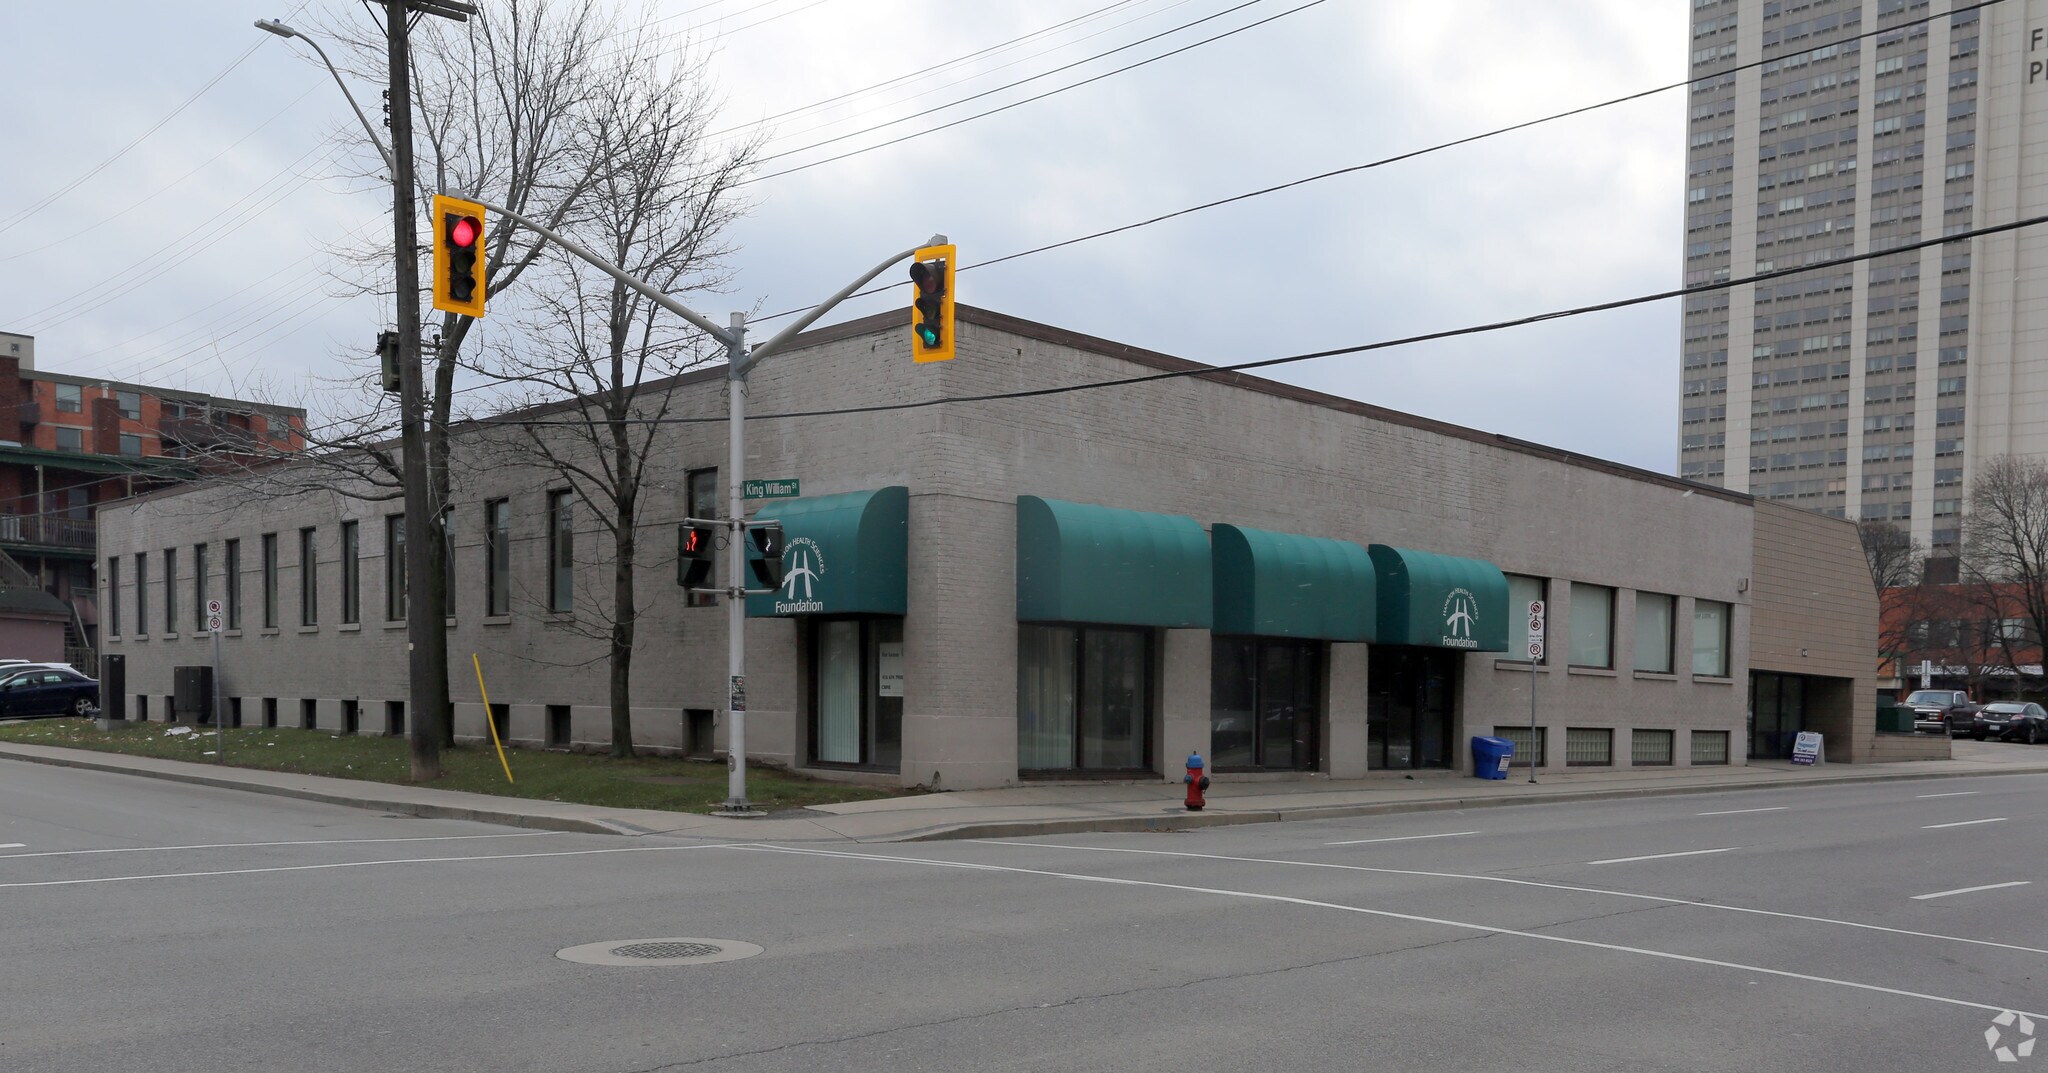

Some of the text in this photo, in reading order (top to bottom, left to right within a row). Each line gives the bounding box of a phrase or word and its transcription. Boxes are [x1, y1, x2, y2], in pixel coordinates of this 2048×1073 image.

[2031, 27, 2048, 52] F
[2030, 59, 2048, 85] P
[746, 481, 797, 498] King William St
[792, 537, 812, 547] HEALTH
[810, 541, 825, 575] SCIENCES
[775, 599, 823, 613] Foundation
[1442, 635, 1478, 648] Foundation
